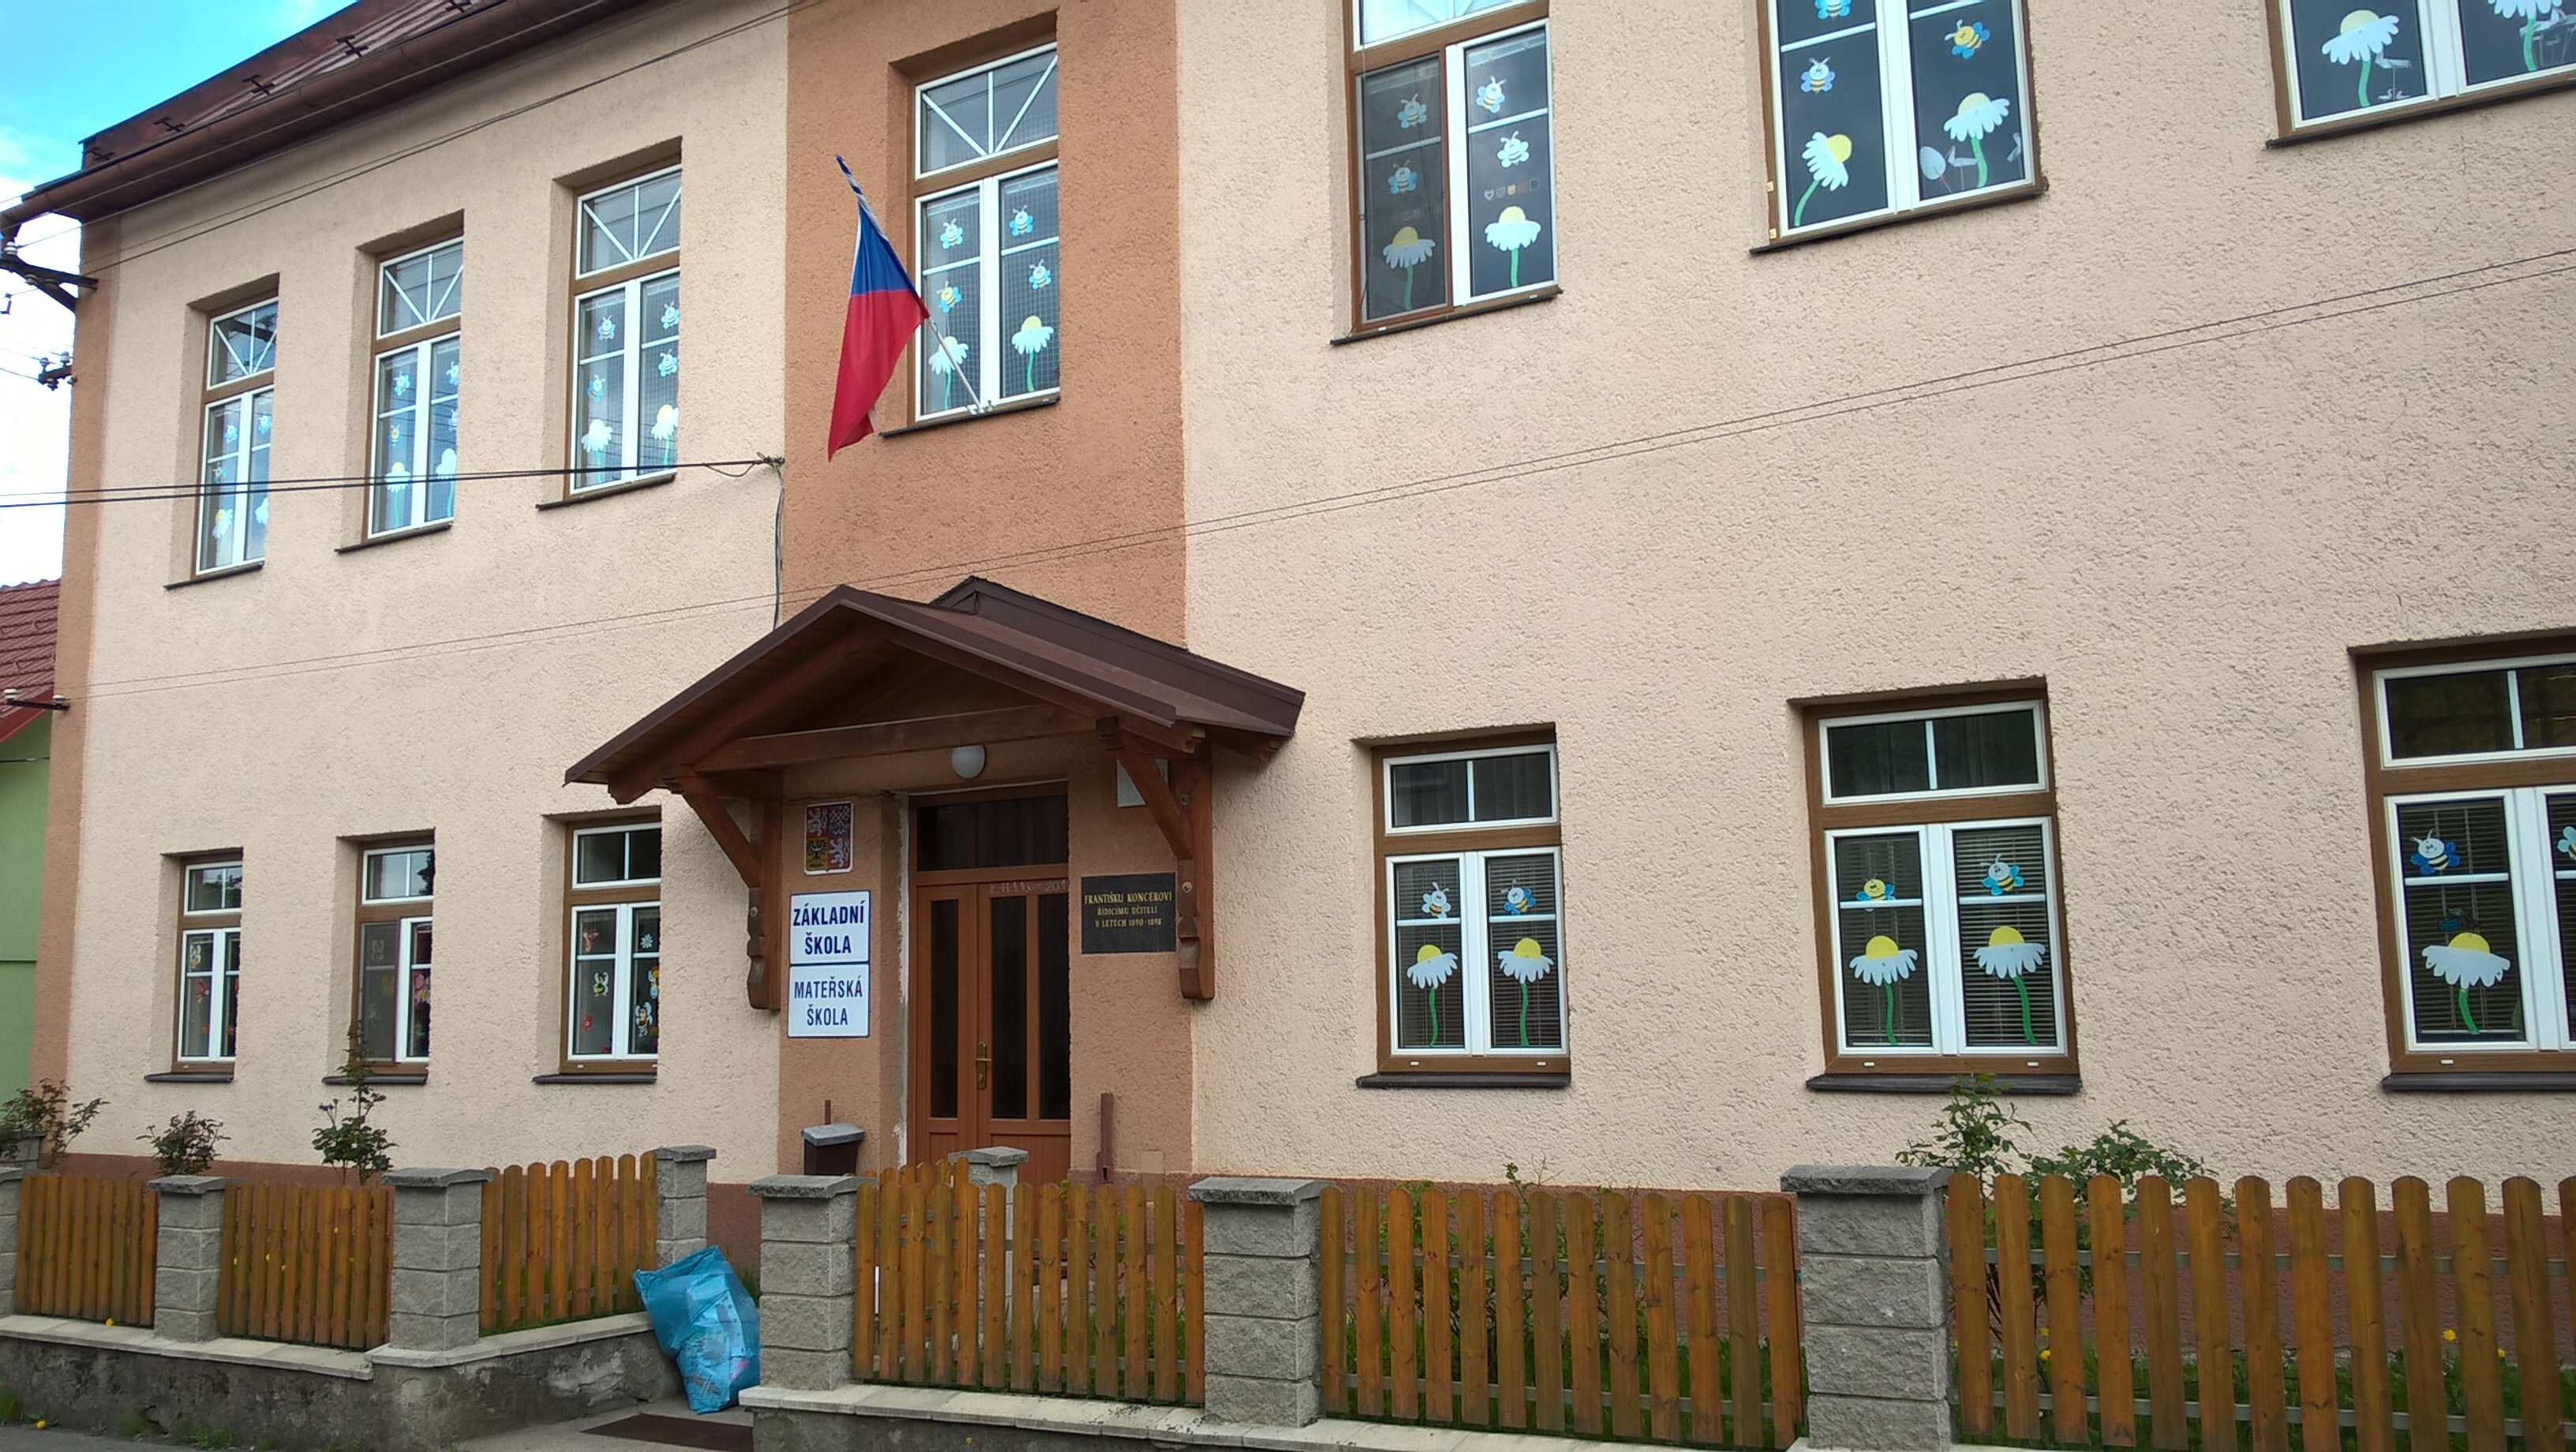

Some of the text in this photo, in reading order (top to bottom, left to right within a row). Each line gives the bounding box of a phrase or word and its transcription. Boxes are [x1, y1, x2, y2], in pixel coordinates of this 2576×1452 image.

[1084, 891, 1172, 904] FRANTIŠKU KONCEROVI
[793, 900, 865, 926] ZÁKLADNÍ
[1131, 904, 1158, 915] UČITELI
[1102, 919, 1127, 927] LETECH
[804, 932, 852, 955] ŠKOLA
[794, 975, 863, 998] MATEŘSKÁ
[807, 1004, 849, 1027] ŠKOLA
